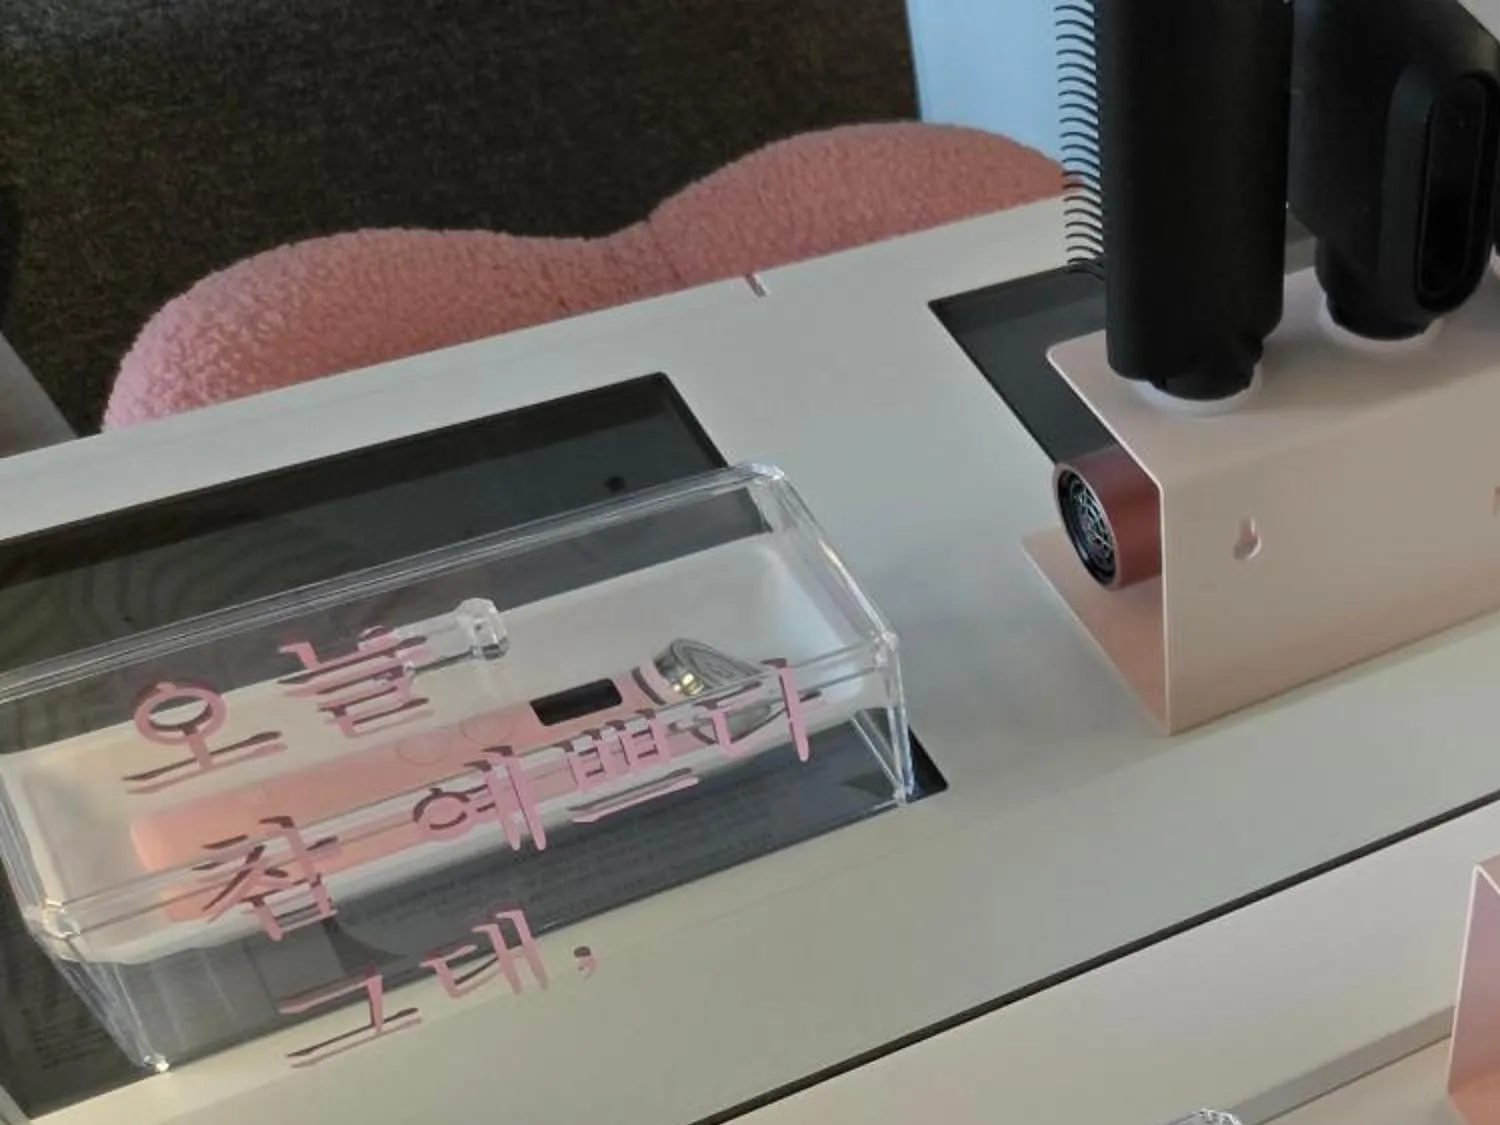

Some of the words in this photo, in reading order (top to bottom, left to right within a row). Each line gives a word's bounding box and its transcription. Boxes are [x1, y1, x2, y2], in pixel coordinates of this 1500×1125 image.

[121, 625, 433, 794] 오늘
[193, 815, 342, 943] 참
[411, 657, 823, 852] 예쁘다
